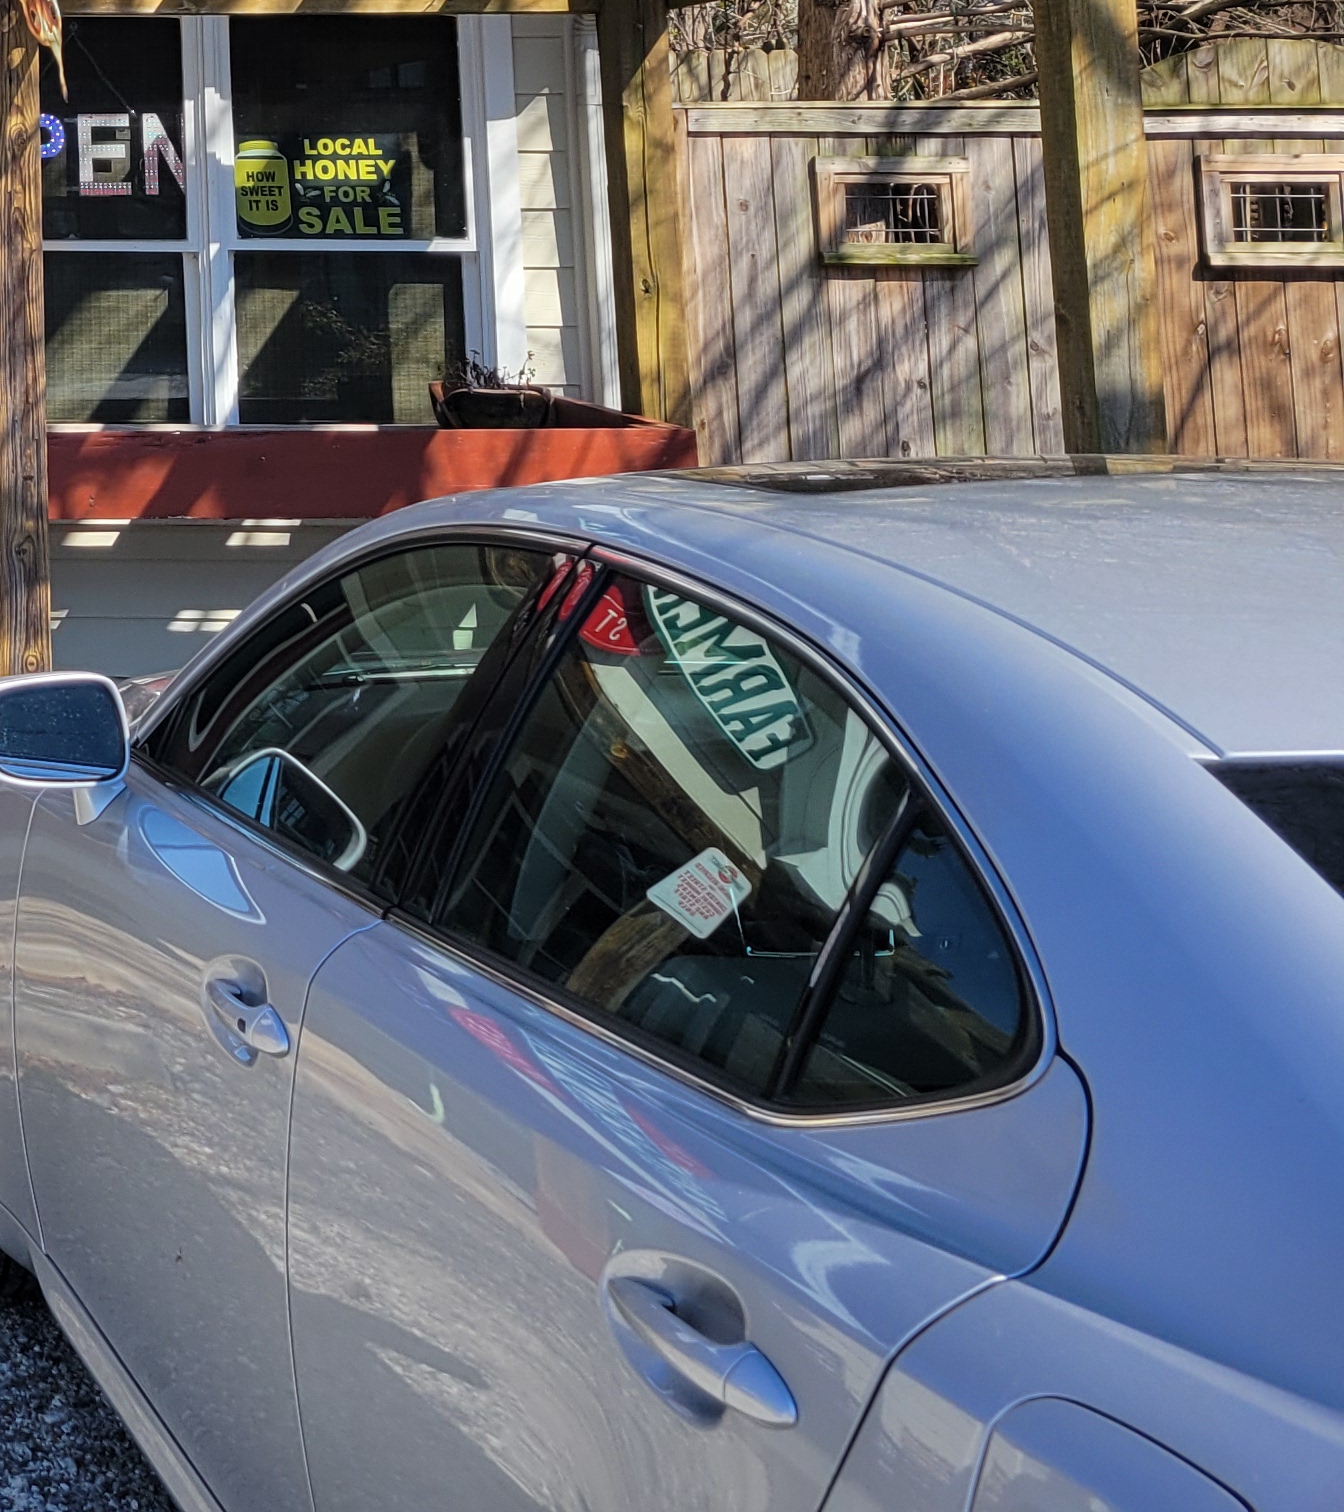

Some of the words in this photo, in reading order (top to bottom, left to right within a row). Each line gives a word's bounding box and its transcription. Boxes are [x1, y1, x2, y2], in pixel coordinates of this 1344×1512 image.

[304, 138, 383, 155] LOCAL
[245, 171, 276, 183] HOW
[293, 159, 396, 180] HONEY
[240, 186, 284, 197] SWEET
[323, 186, 372, 203] FOR
[248, 200, 261, 212] IT
[266, 200, 279, 211] IS
[298, 206, 404, 235] SALE
